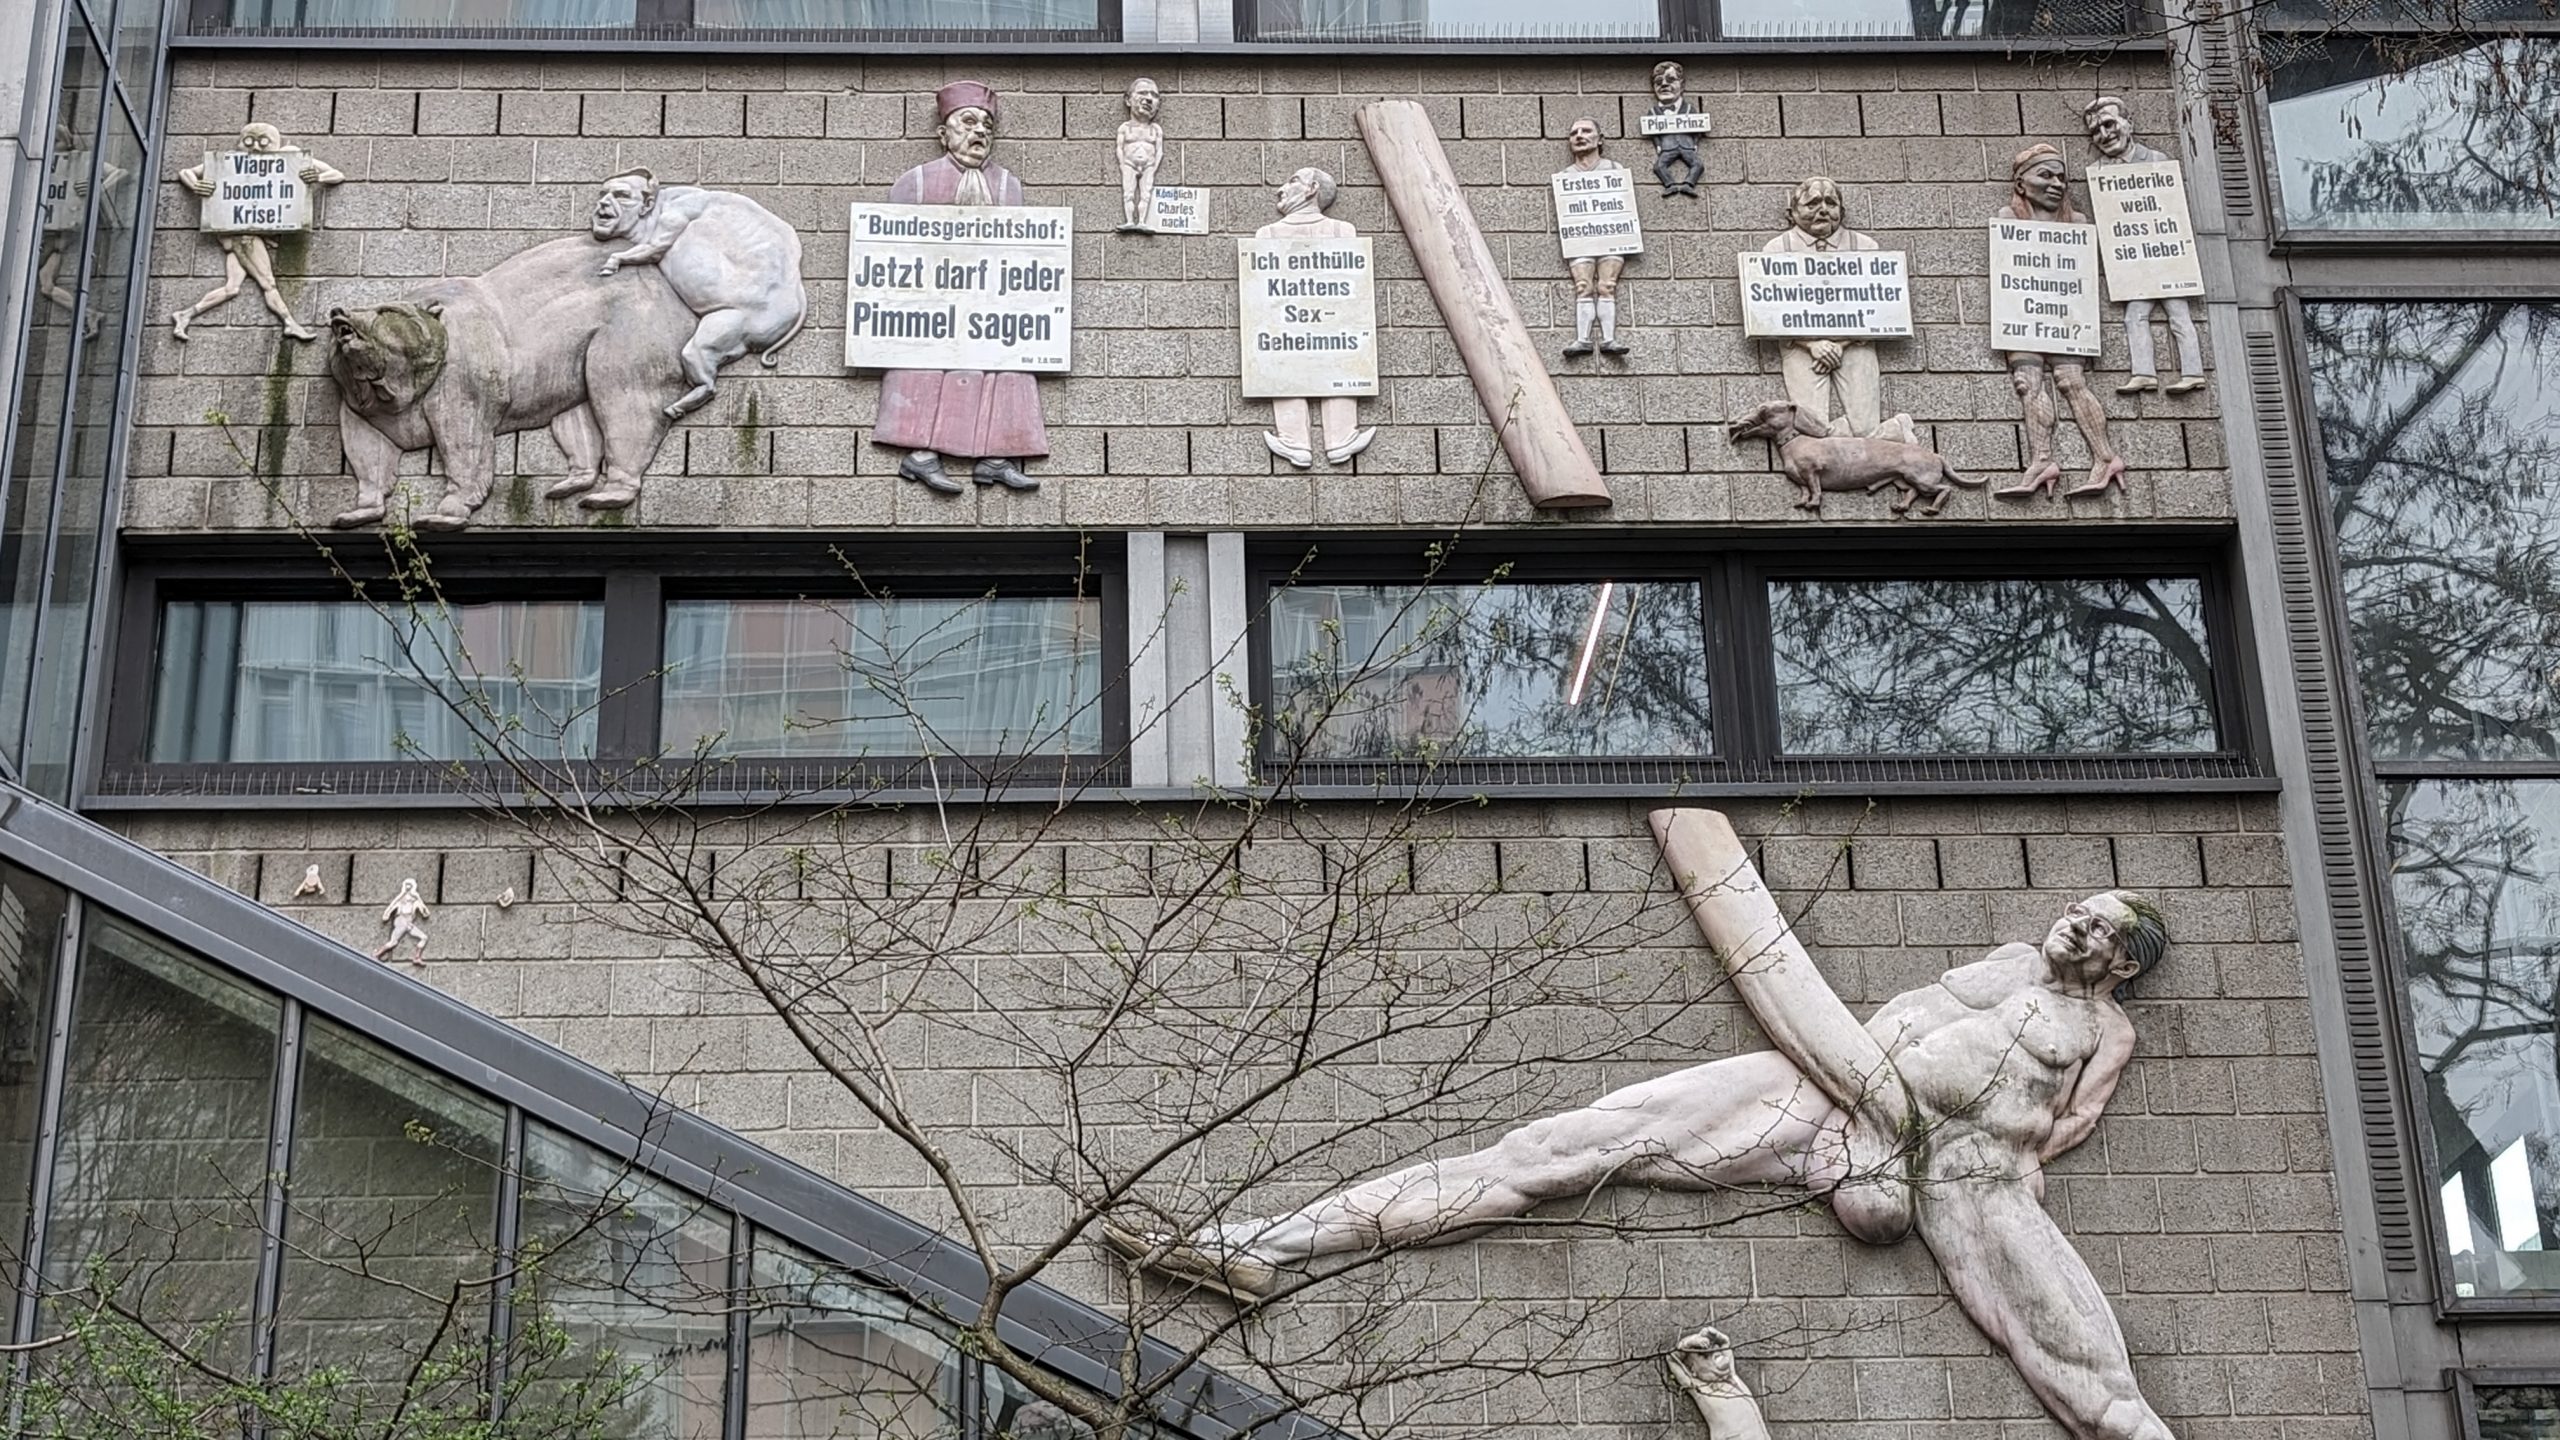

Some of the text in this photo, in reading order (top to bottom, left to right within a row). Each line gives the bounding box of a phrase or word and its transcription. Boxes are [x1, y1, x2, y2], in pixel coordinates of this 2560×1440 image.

[223, 180, 294, 200] boomt in
[1604, 175, 1623, 189] Tor
[1157, 201, 1194, 215] Charles
[1568, 198, 1624, 213] mit Penis
[2120, 195, 2162, 213] weiß,
[2113, 218, 2178, 237] dass ich
[2039, 229, 2088, 246] macht
[1288, 251, 1365, 270] enthülle
[2013, 252, 2076, 270] mich im
[2114, 244, 2137, 260] sie
[854, 255, 1065, 296] Jetzt darf jeder
[1804, 257, 1863, 276] Dackel
[1870, 257, 1898, 276] der
[1267, 278, 1350, 297] Klattens
[1750, 282, 1902, 305] Schwiegermutter
[2001, 273, 2082, 296] Dschungel
[1284, 304, 1335, 323] Sex-
[2023, 298, 2068, 319] Camp
[852, 301, 956, 339] Pimmel
[2002, 323, 2029, 336] zur
